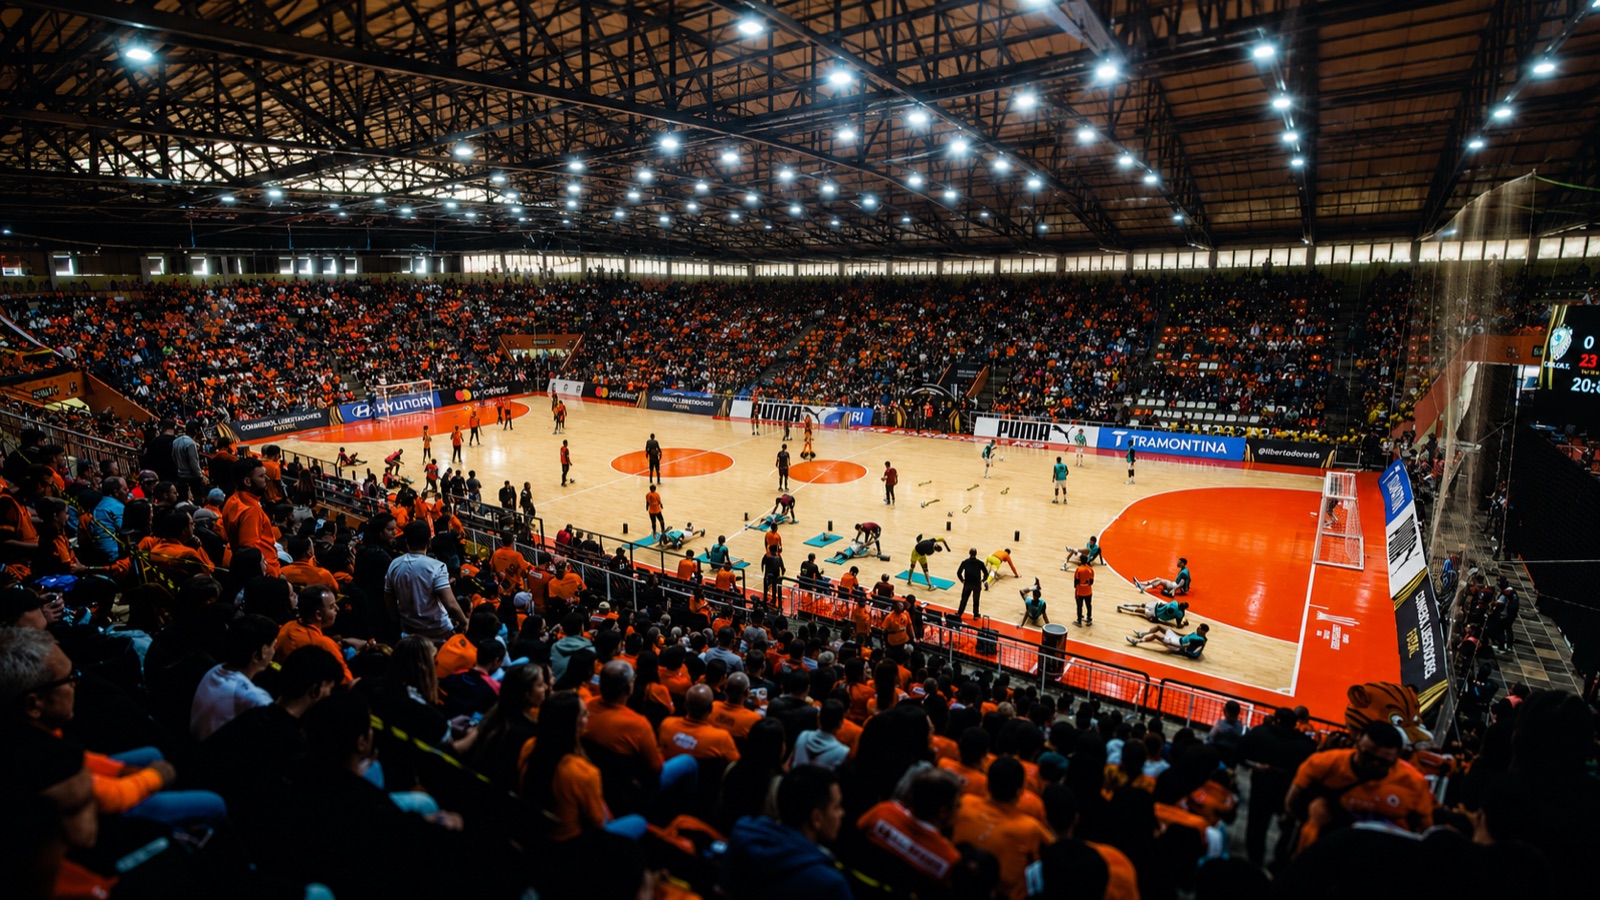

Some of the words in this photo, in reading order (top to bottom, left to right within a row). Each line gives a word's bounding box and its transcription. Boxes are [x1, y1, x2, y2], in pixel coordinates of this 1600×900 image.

[1584, 335, 1595, 349] 0
[1579, 353, 1598, 368] 23
[997, 420, 1051, 441] PUMA
[1130, 434, 1227, 455] TRAMONTINA
